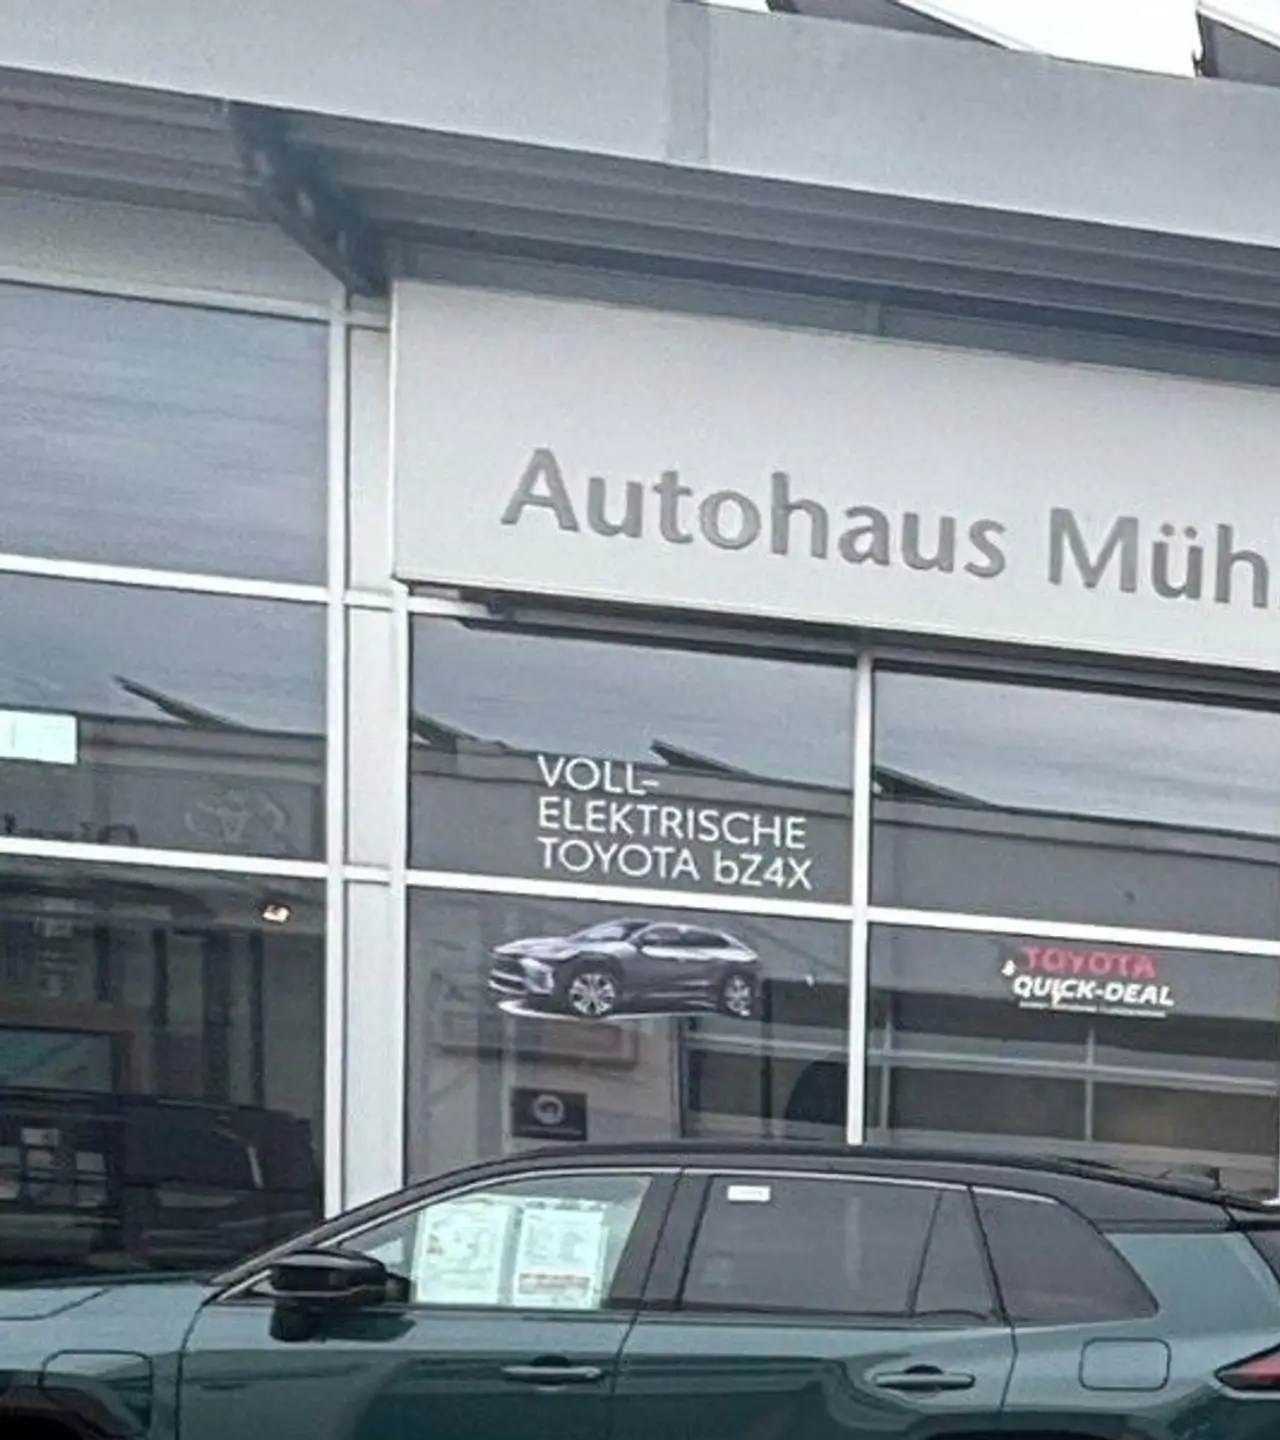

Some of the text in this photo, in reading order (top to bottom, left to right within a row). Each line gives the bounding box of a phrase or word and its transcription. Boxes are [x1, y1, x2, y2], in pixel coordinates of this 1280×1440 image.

[500, 448, 1006, 580] Autohaus
[537, 754, 660, 795] VOLL-
[538, 796, 807, 849] ELEKTRISCHE
[536, 836, 812, 890] TOYOTA bZ4X
[1020, 944, 1157, 979] TOYOTA
[1013, 975, 1174, 1007] QUICK-DEAL
